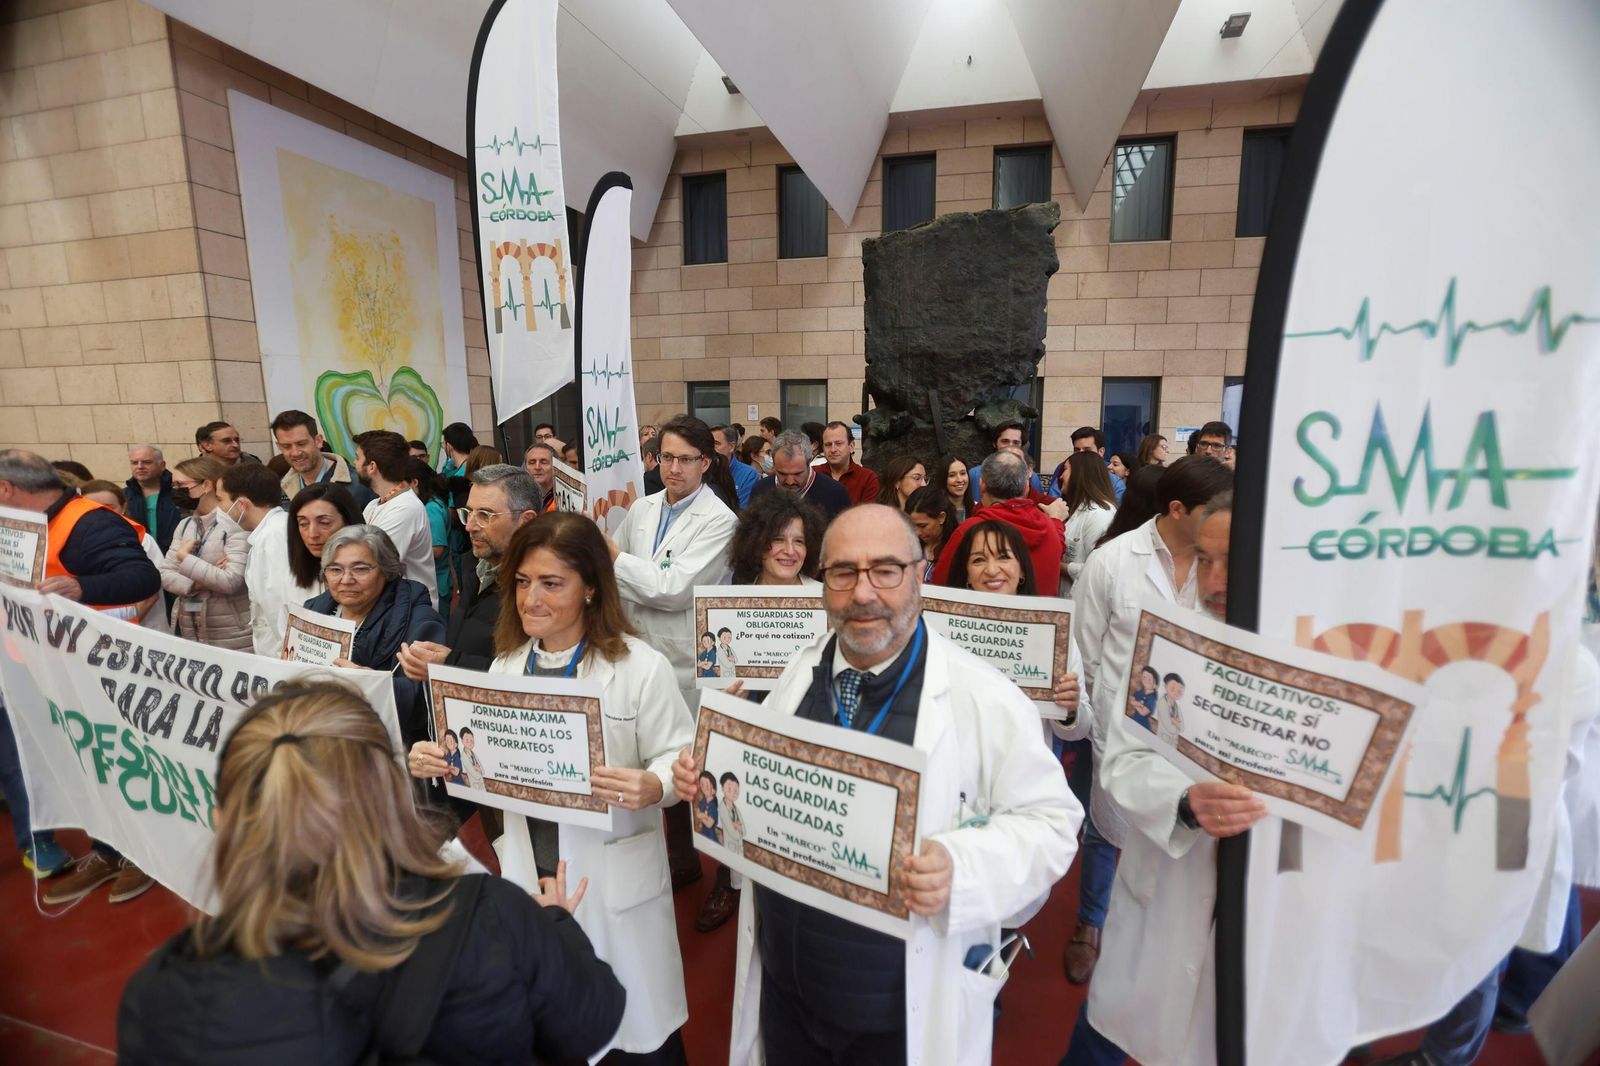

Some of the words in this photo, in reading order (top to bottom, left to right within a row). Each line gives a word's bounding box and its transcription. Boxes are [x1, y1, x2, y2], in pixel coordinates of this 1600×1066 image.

[480, 166, 554, 205] SMA
[490, 203, 555, 222] CÓRDOBA
[1294, 400, 1578, 514] SMA
[1308, 511, 1560, 561] CÓRDOBA
[736, 611, 751, 619] MIS
[752, 611, 794, 619] GUARDIAS
[795, 611, 813, 619] SON
[745, 621, 804, 629] OBLIGATORIAS
[948, 617, 1013, 636] REGULACIÓN
[1015, 626, 1029, 636] DE
[735, 631, 754, 641] ¿Por
[755, 631, 769, 641] qué
[782, 632, 815, 640] cotizan?
[950, 631, 969, 642] LAS
[970, 634, 1024, 648] GUARDIAS
[1013, 663, 1046, 677] SMA
[1203, 661, 1341, 716] FACULTATIVOS:
[471, 705, 518, 720] JORNADA
[520, 709, 567, 725] MÁXIMA
[1212, 684, 1297, 724] FIDELIZAR
[1301, 713, 1320, 729] SÍ
[182, 701, 223, 752] LA
[470, 718, 518, 735] MENSUAL:
[520, 726, 537, 738] NO
[539, 728, 548, 738] A
[550, 729, 572, 740] LOS
[1192, 695, 1296, 742] SECUESTRAR
[1301, 734, 1331, 752] NO
[487, 735, 555, 754] PRORRATEOS
[547, 760, 583, 777] SMA
[742, 750, 833, 790] REGULACIÓN
[837, 779, 856, 797] DE
[1233, 753, 1286, 778] profesión
[1285, 748, 1341, 777] SMA
[493, 771, 509, 781] para
[510, 774, 519, 782] mi
[520, 776, 553, 787] profesión
[745, 771, 770, 792] LAS
[773, 781, 849, 817] GUARDIAS
[746, 792, 844, 838] LOCALIZADAS
[766, 826, 779, 838] Un
[757, 836, 777, 851] para
[779, 843, 790, 856] mi
[792, 849, 837, 873] profesión
[832, 842, 879, 872] SMA
